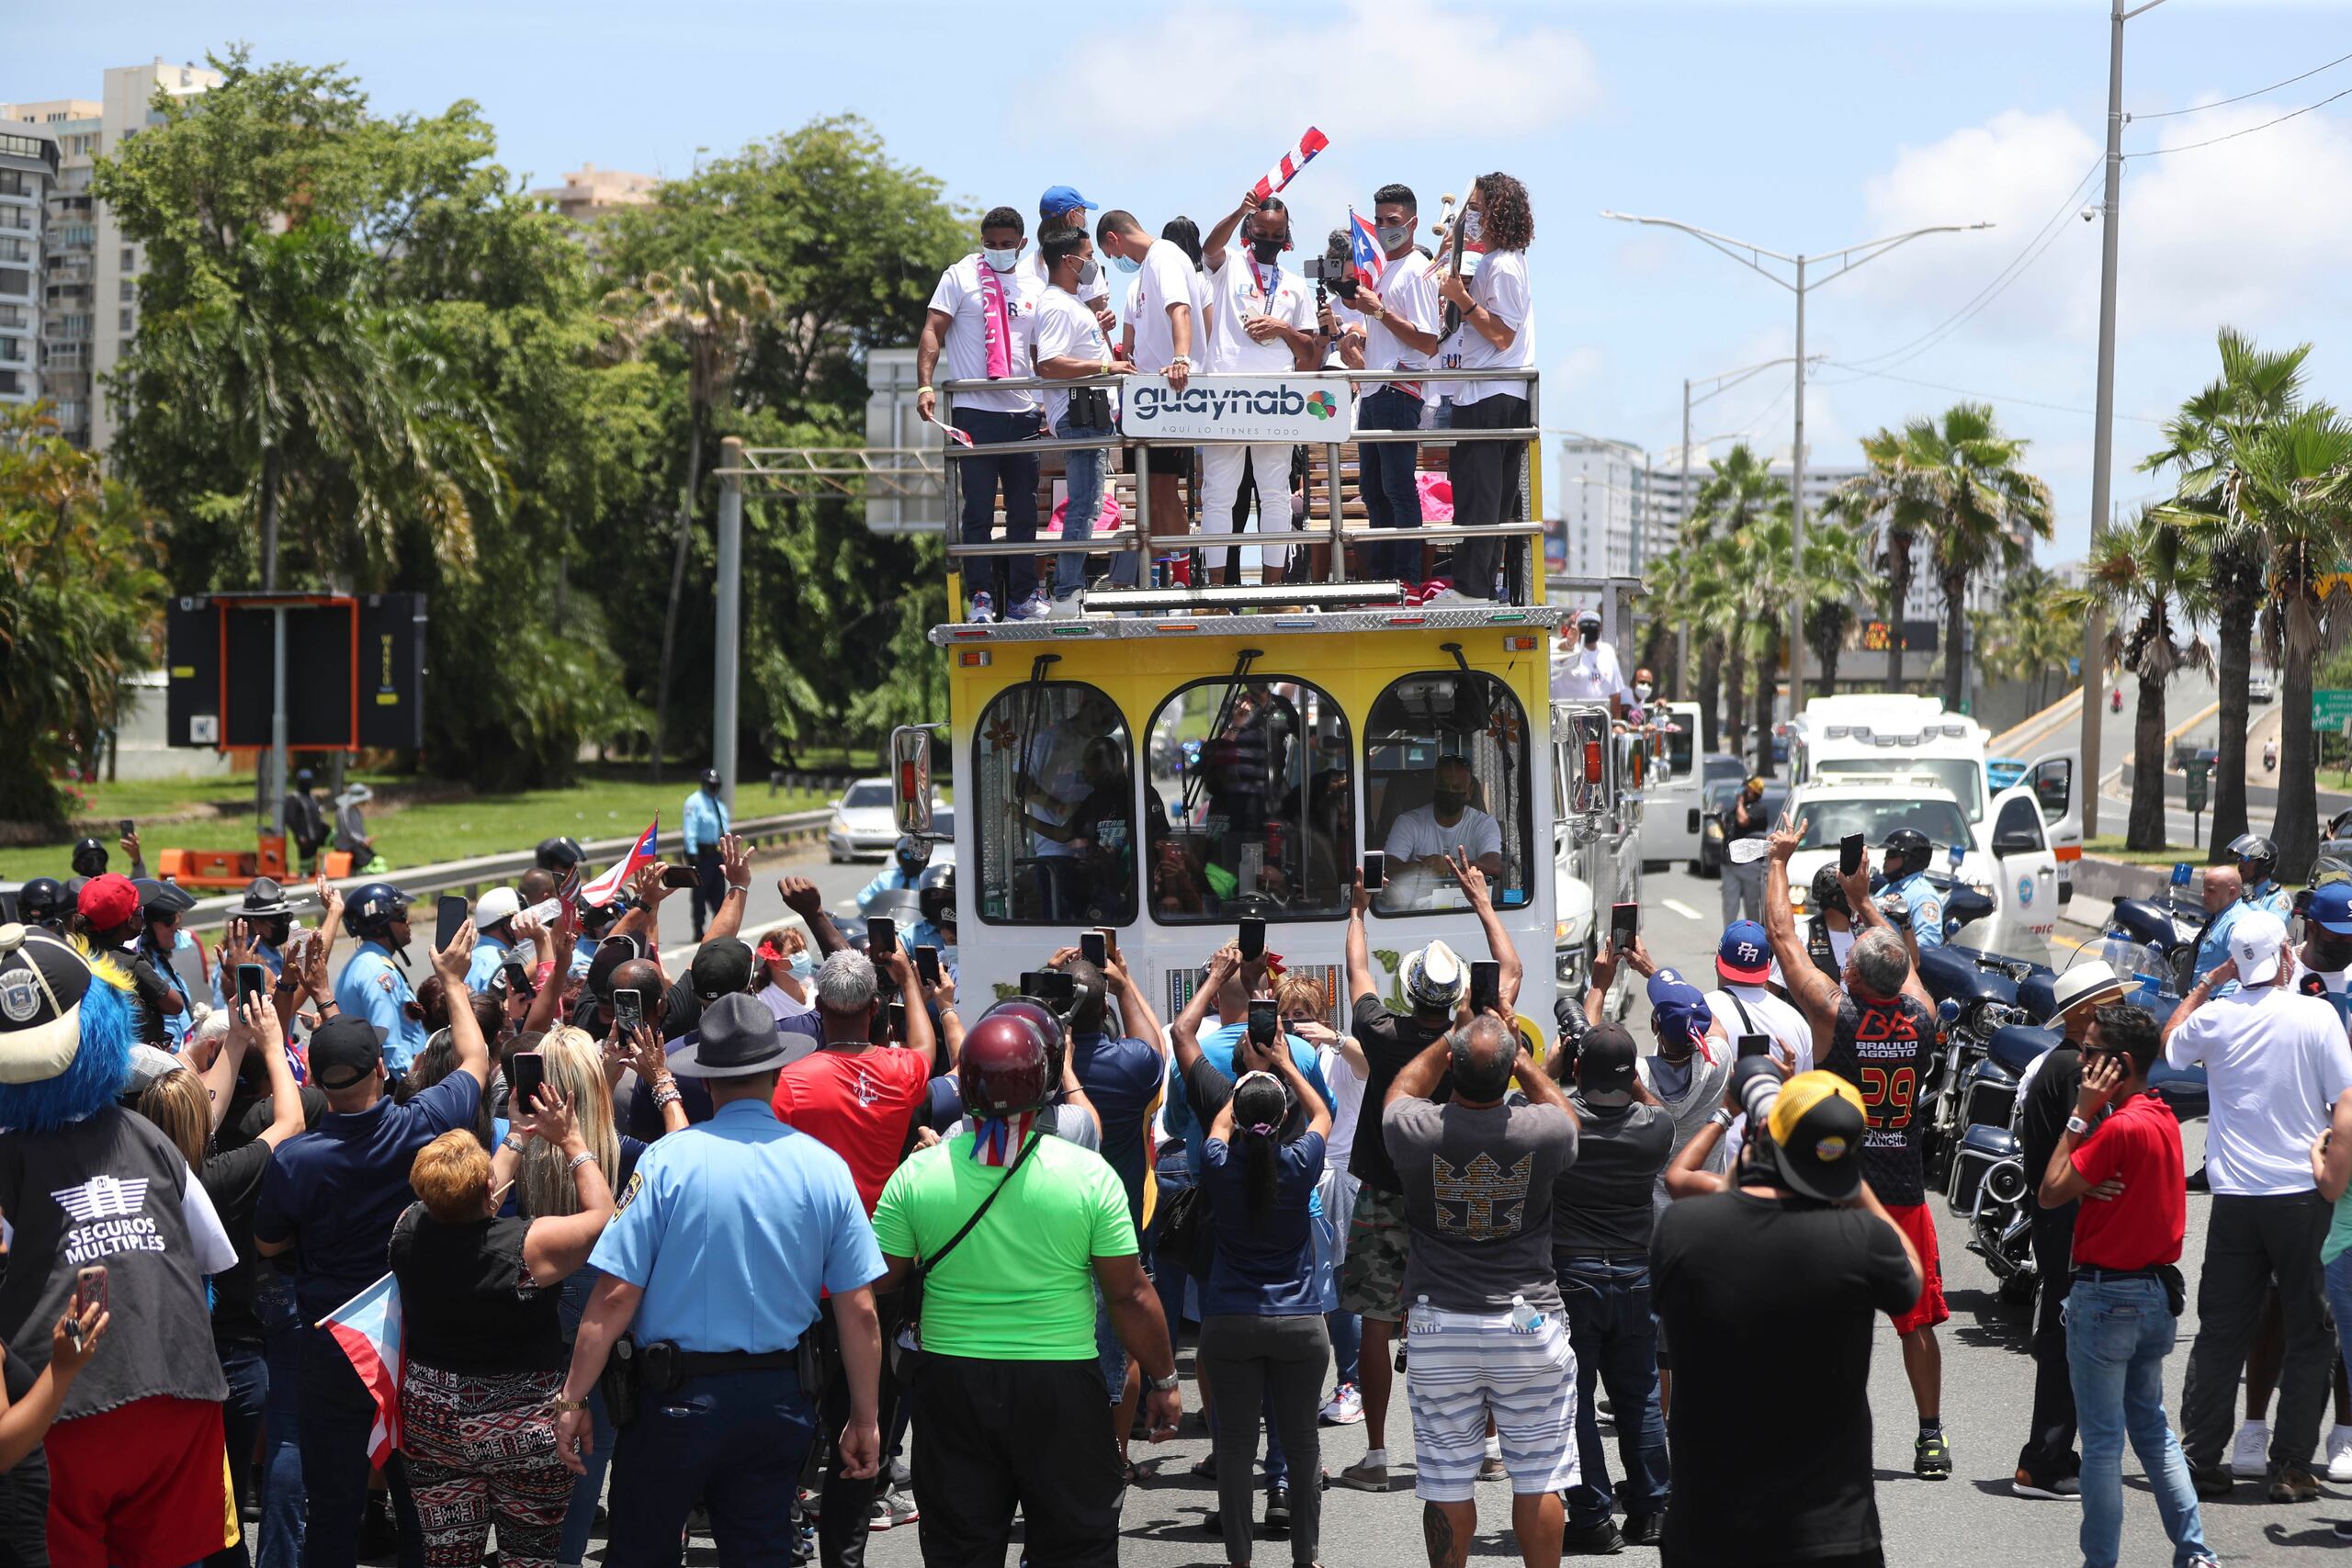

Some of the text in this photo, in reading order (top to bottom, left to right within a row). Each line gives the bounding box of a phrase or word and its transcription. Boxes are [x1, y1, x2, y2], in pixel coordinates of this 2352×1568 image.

[1161, 425, 1299, 436] AQUÍ LO TIENES TODO
[1856, 1040, 1918, 1050] BRAULIO
[1857, 1049, 1917, 1058] AGOSTO
[1860, 1066, 1916, 1128] 29
[1862, 1136, 1907, 1146] PANCHO
[68, 1217, 155, 1247] SEGUROS
[65, 1235, 165, 1264] MULTIPLES
